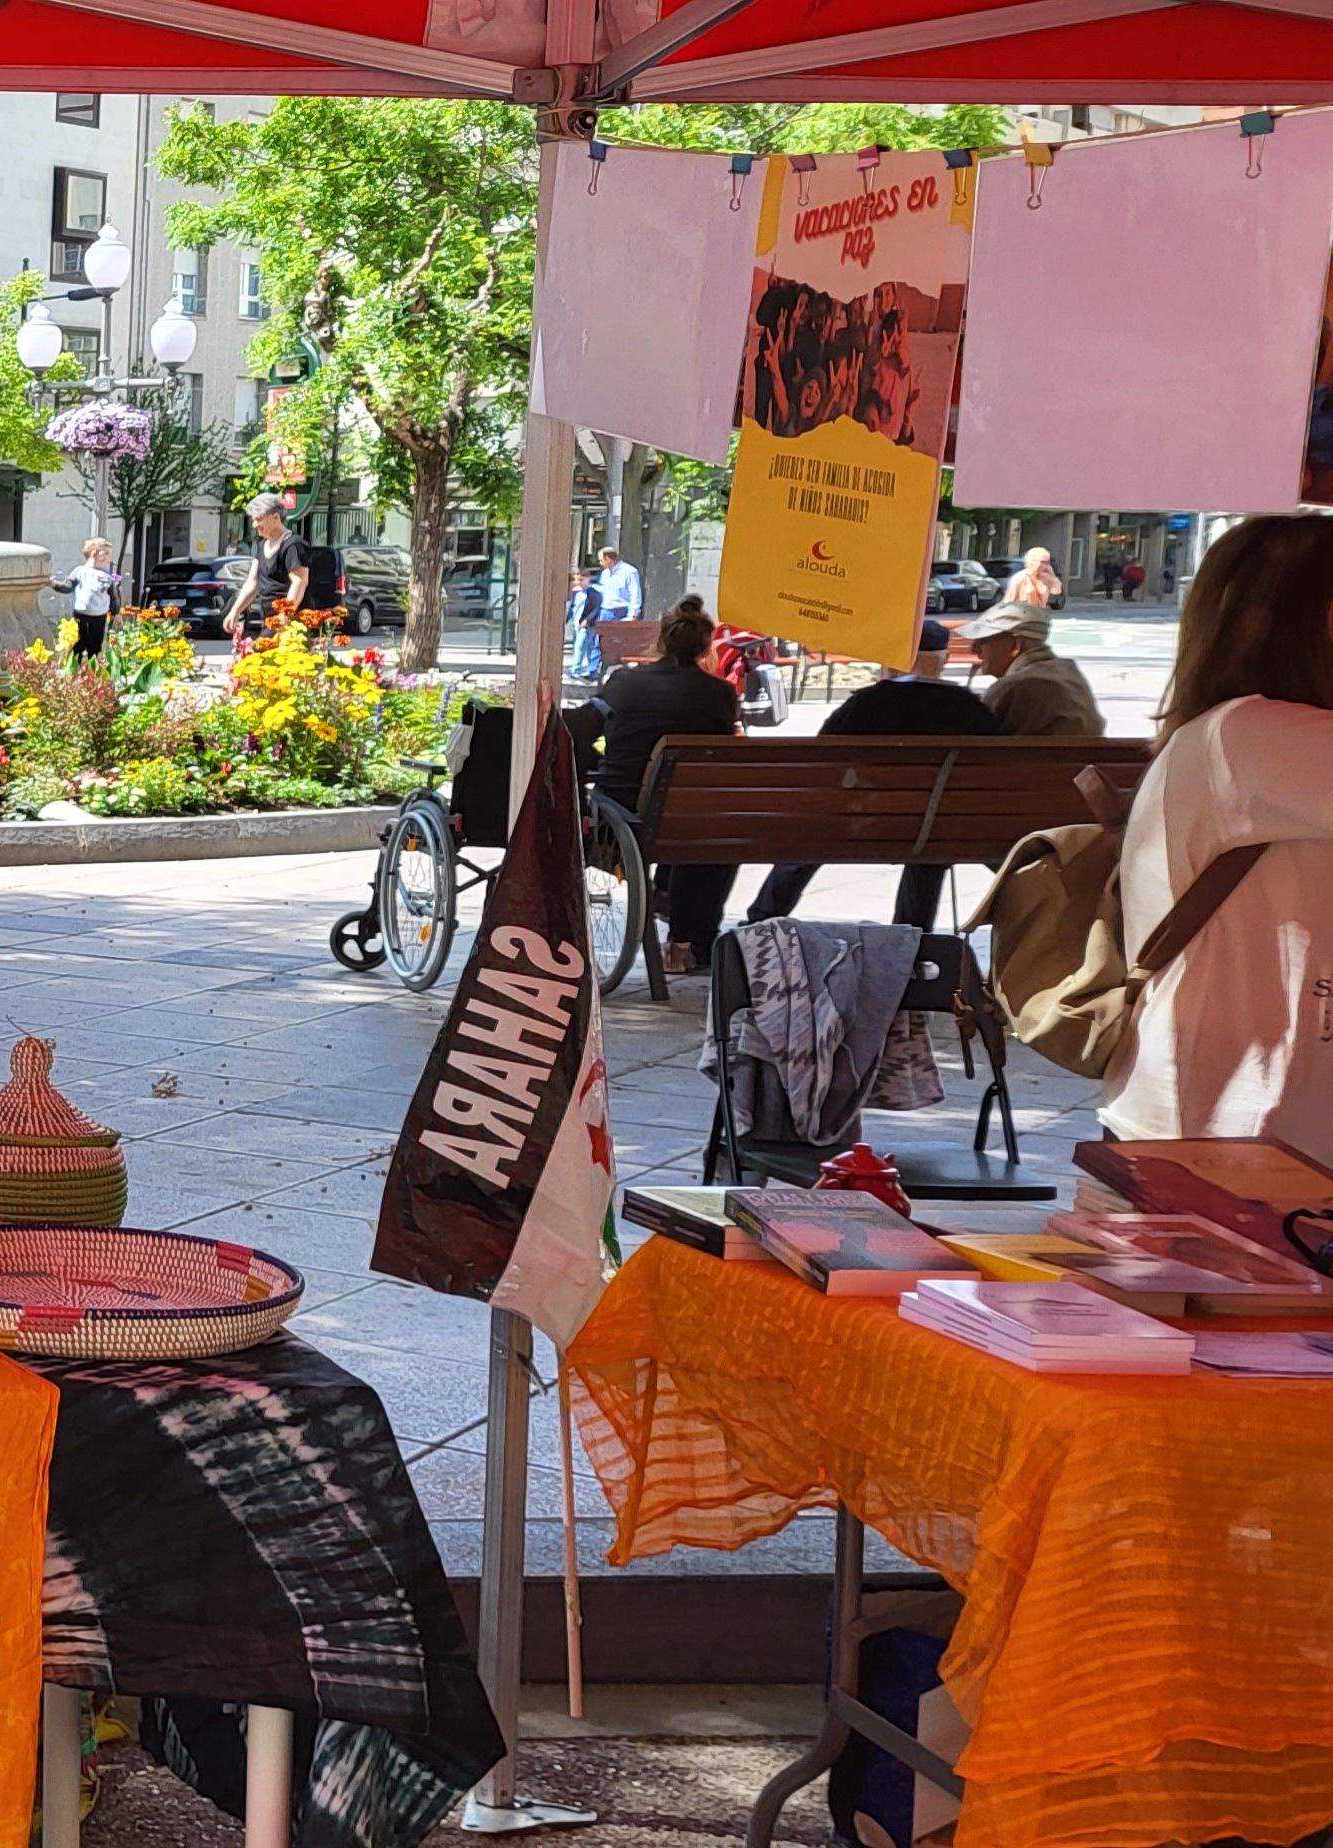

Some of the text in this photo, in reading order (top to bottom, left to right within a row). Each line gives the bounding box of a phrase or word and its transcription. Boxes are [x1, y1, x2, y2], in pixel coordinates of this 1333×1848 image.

[768, 453, 896, 498] ¿QUIERES SER FAMILIA DE ACOGIDA
[788, 485, 870, 525] DE NIÑOS SAHARAUIS?
[796, 557, 846, 578] alouda
